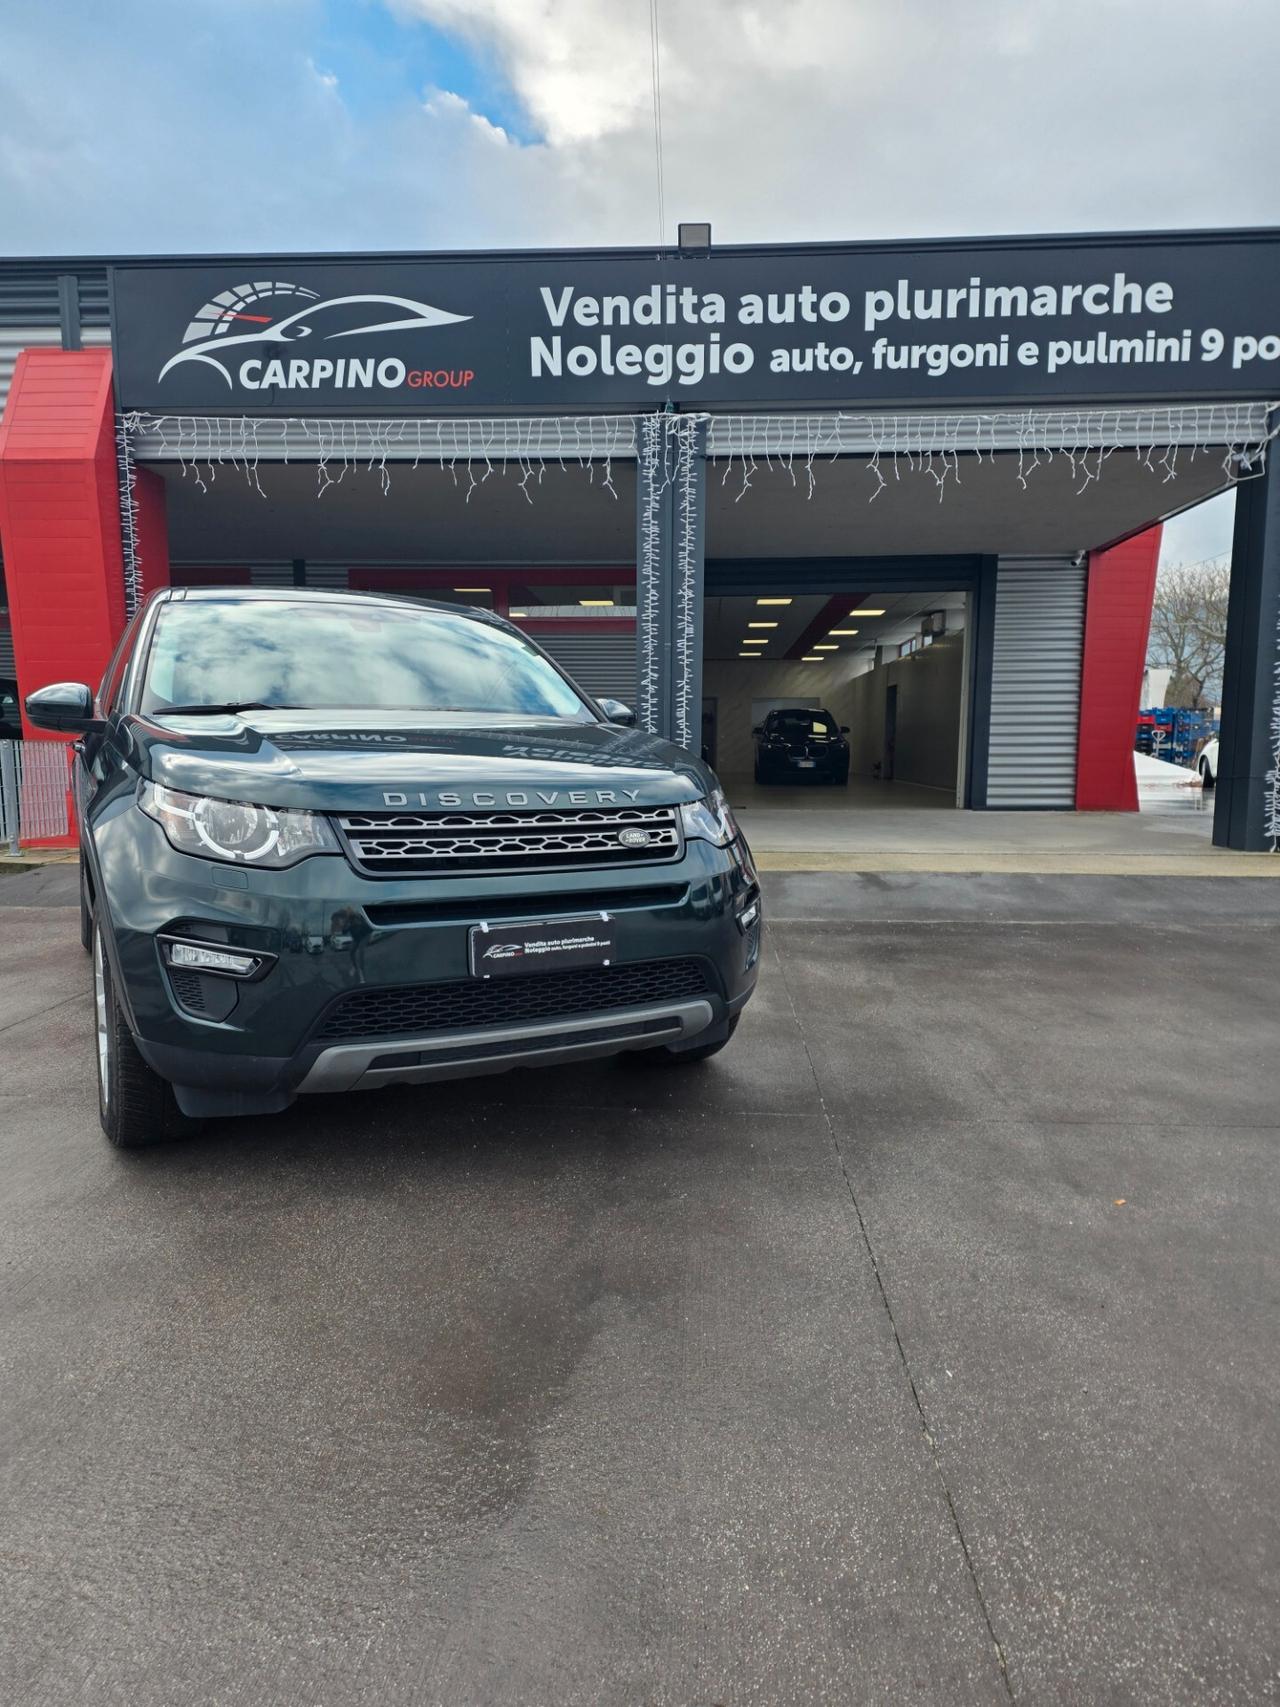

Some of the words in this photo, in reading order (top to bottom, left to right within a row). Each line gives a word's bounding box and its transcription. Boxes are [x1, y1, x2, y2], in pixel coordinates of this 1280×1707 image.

[539, 284, 727, 327] Vendita
[738, 286, 851, 326] auto
[864, 272, 1174, 332] plurimarche
[239, 358, 406, 390] CARPINO
[407, 370, 474, 388] GROUP
[530, 332, 755, 386] Noleggio
[769, 341, 864, 375] auto,
[871, 335, 1009, 377] furgoni
[1017, 341, 1040, 366] e
[1046, 329, 1192, 374] pulmini
[1200, 328, 1225, 362] 9
[382, 789, 640, 807] DISCOVERY
